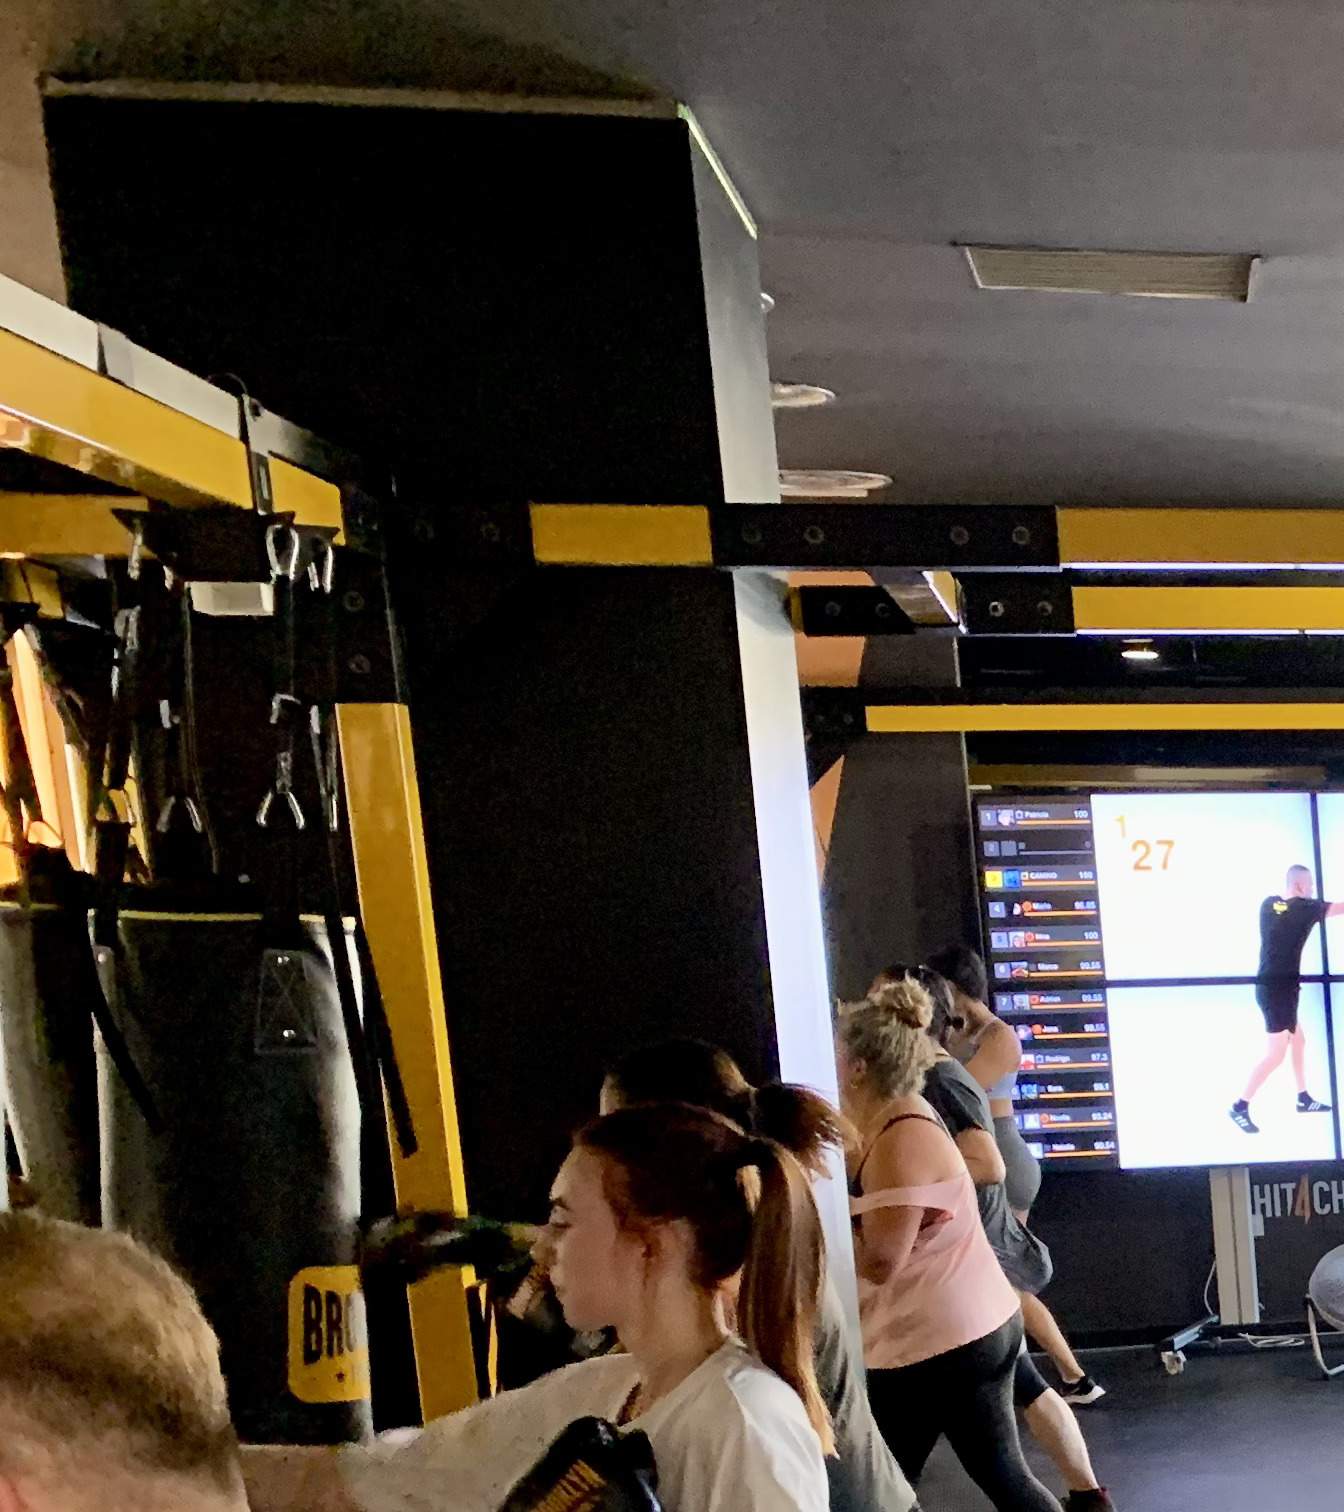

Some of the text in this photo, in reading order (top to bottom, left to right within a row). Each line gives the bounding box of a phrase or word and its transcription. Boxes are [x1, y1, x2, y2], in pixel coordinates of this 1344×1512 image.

[1073, 810, 1088, 818] 100
[1114, 814, 1126, 840] 1
[1131, 839, 1175, 871] 27
[1079, 871, 1093, 879] 100
[1084, 932, 1099, 940] 100
